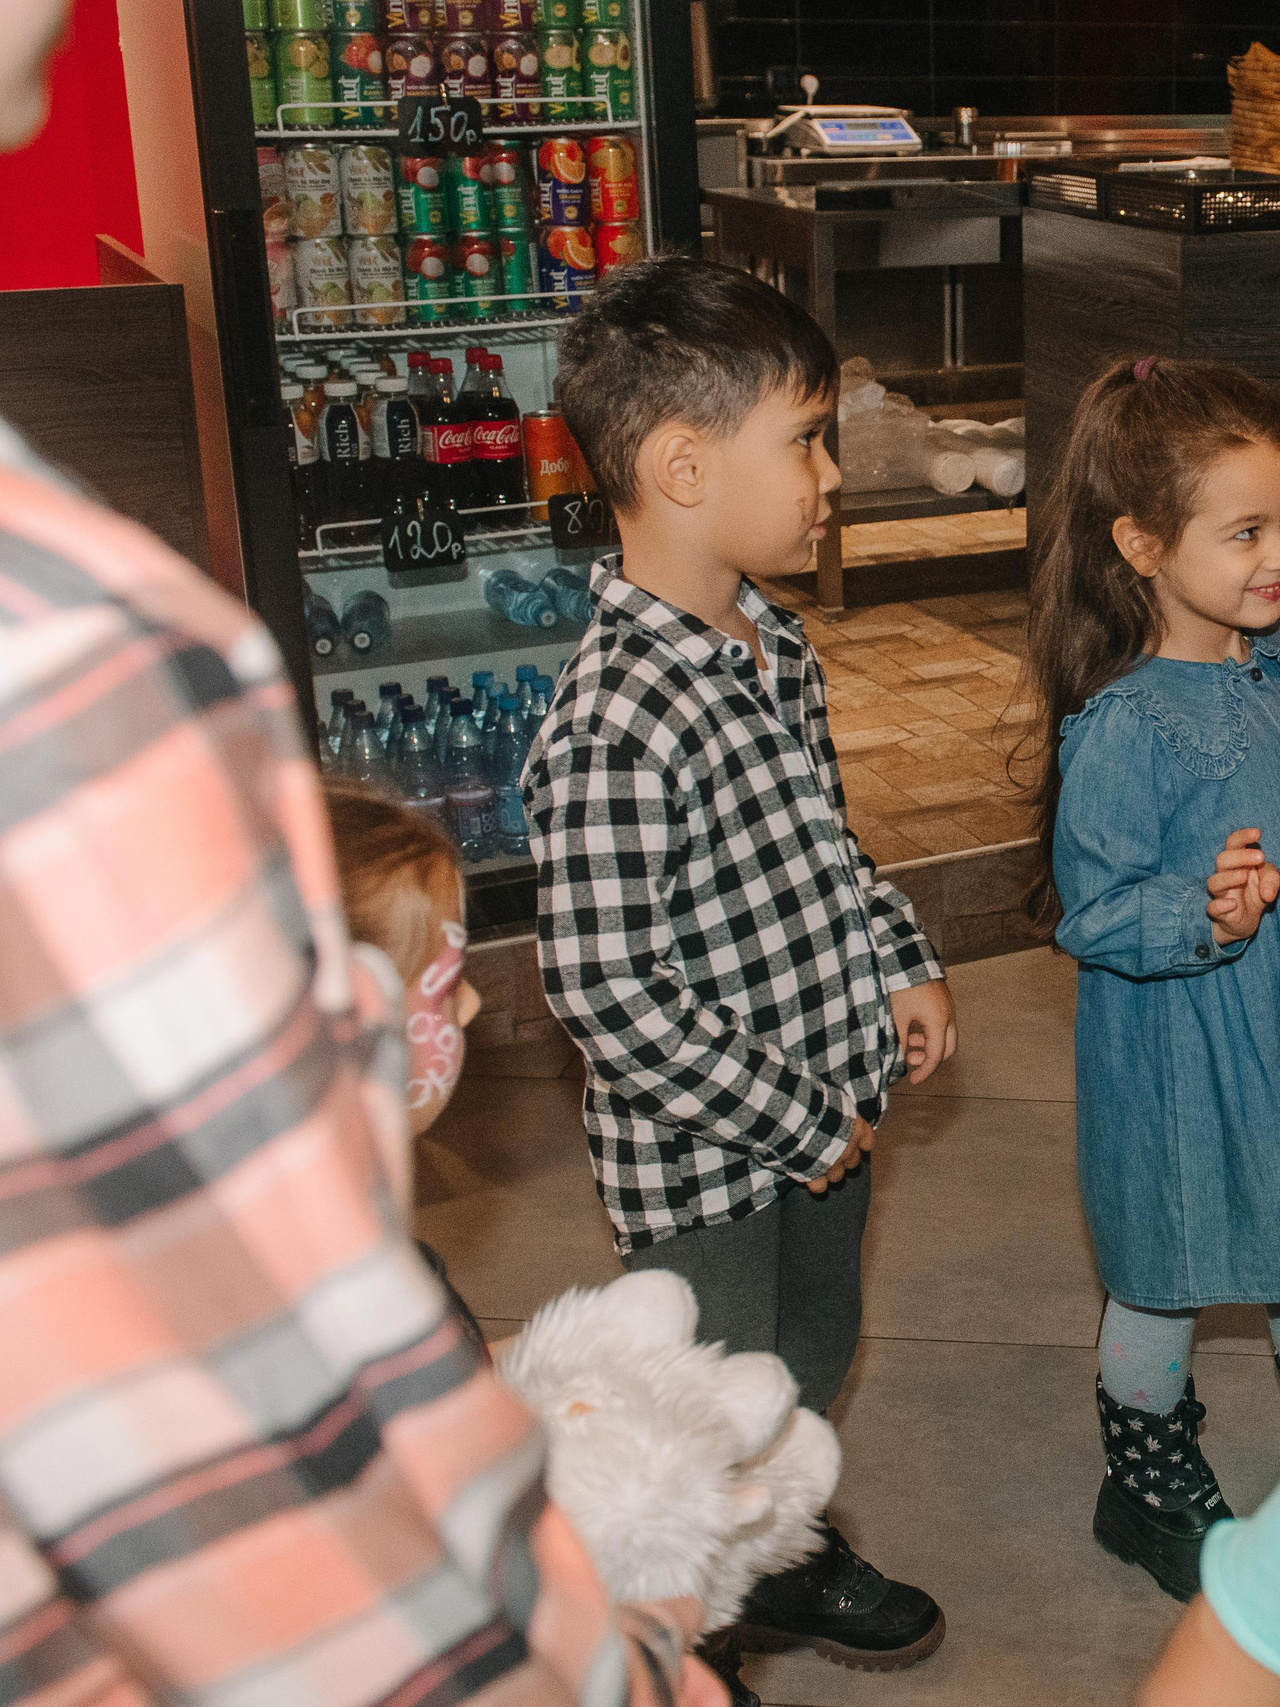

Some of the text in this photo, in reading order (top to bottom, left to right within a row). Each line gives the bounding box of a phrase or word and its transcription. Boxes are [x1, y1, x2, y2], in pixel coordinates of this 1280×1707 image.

[545, 73, 567, 115] Vnut
[589, 71, 610, 112] Vnut
[334, 423, 351, 458] Rich
[397, 418, 412, 453] Rich
